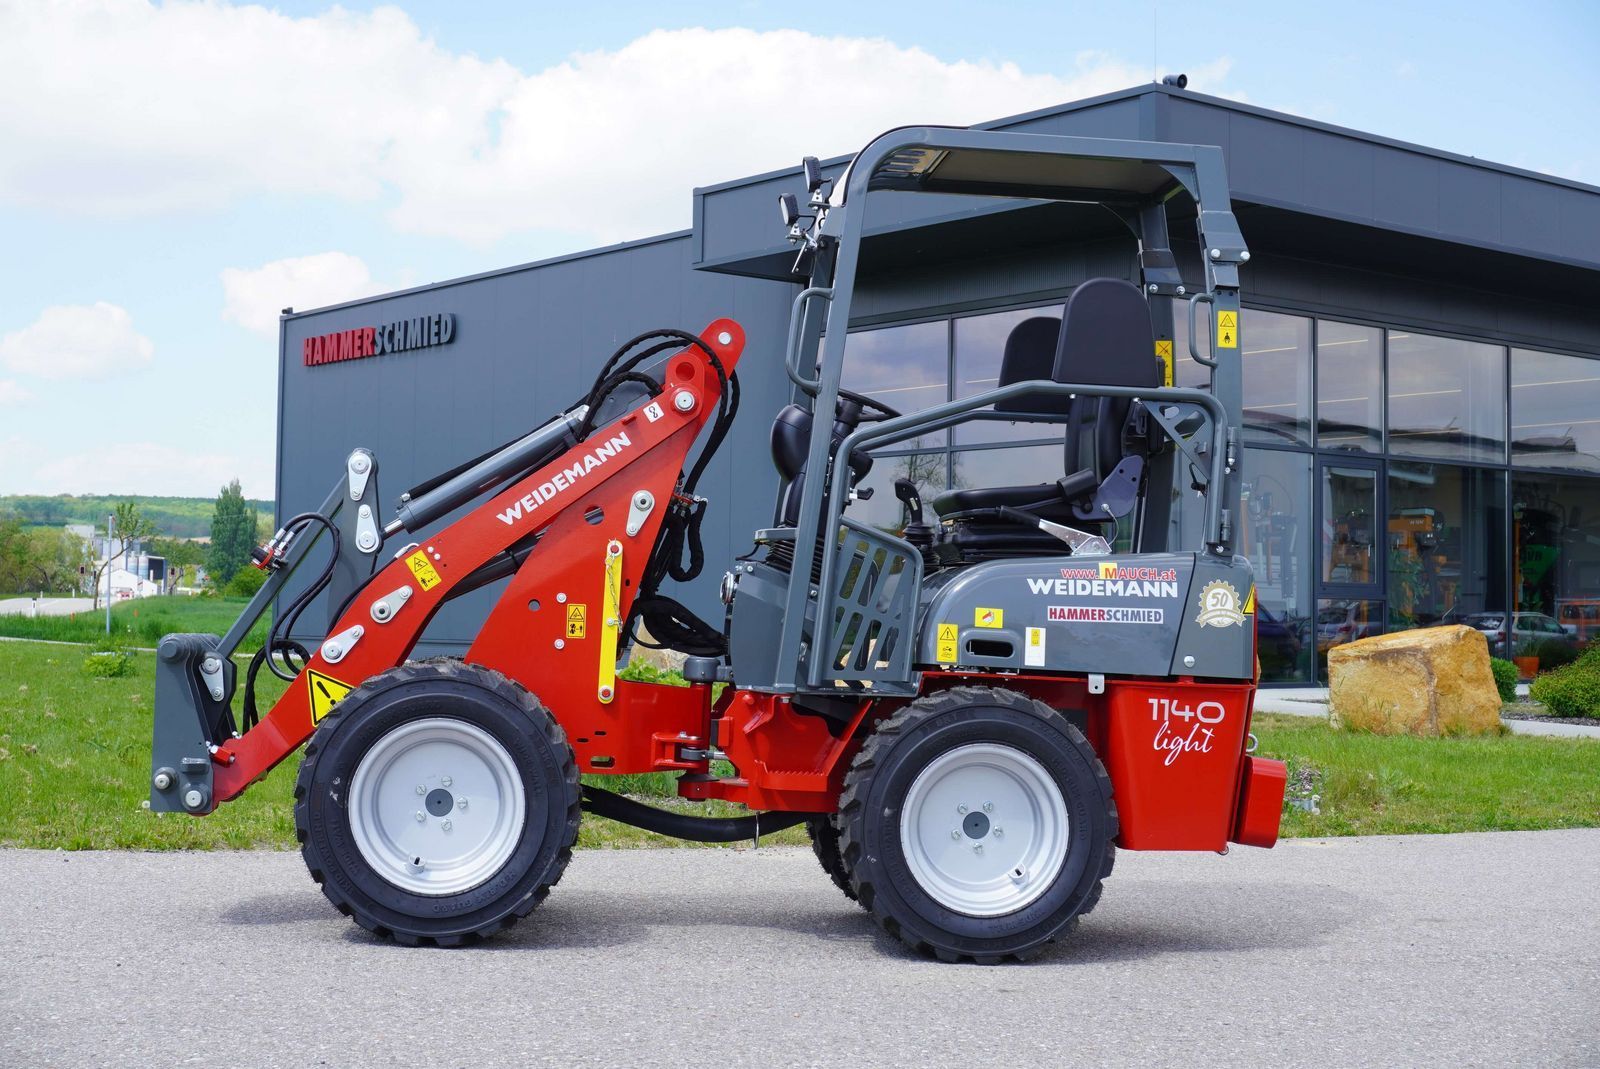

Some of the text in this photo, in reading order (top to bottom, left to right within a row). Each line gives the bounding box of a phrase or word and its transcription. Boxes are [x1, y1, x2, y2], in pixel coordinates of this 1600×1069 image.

[303, 312, 456, 367] HAMMERSCHMIED
[496, 431, 632, 526] WEIDEMANN
[1027, 578, 1178, 598] WEIDEMANN
[1211, 592, 1229, 608] 50
[1049, 607, 1162, 623] HAMMERSCHMIED
[1148, 698, 1226, 724] 1140
[1153, 720, 1215, 767] light
